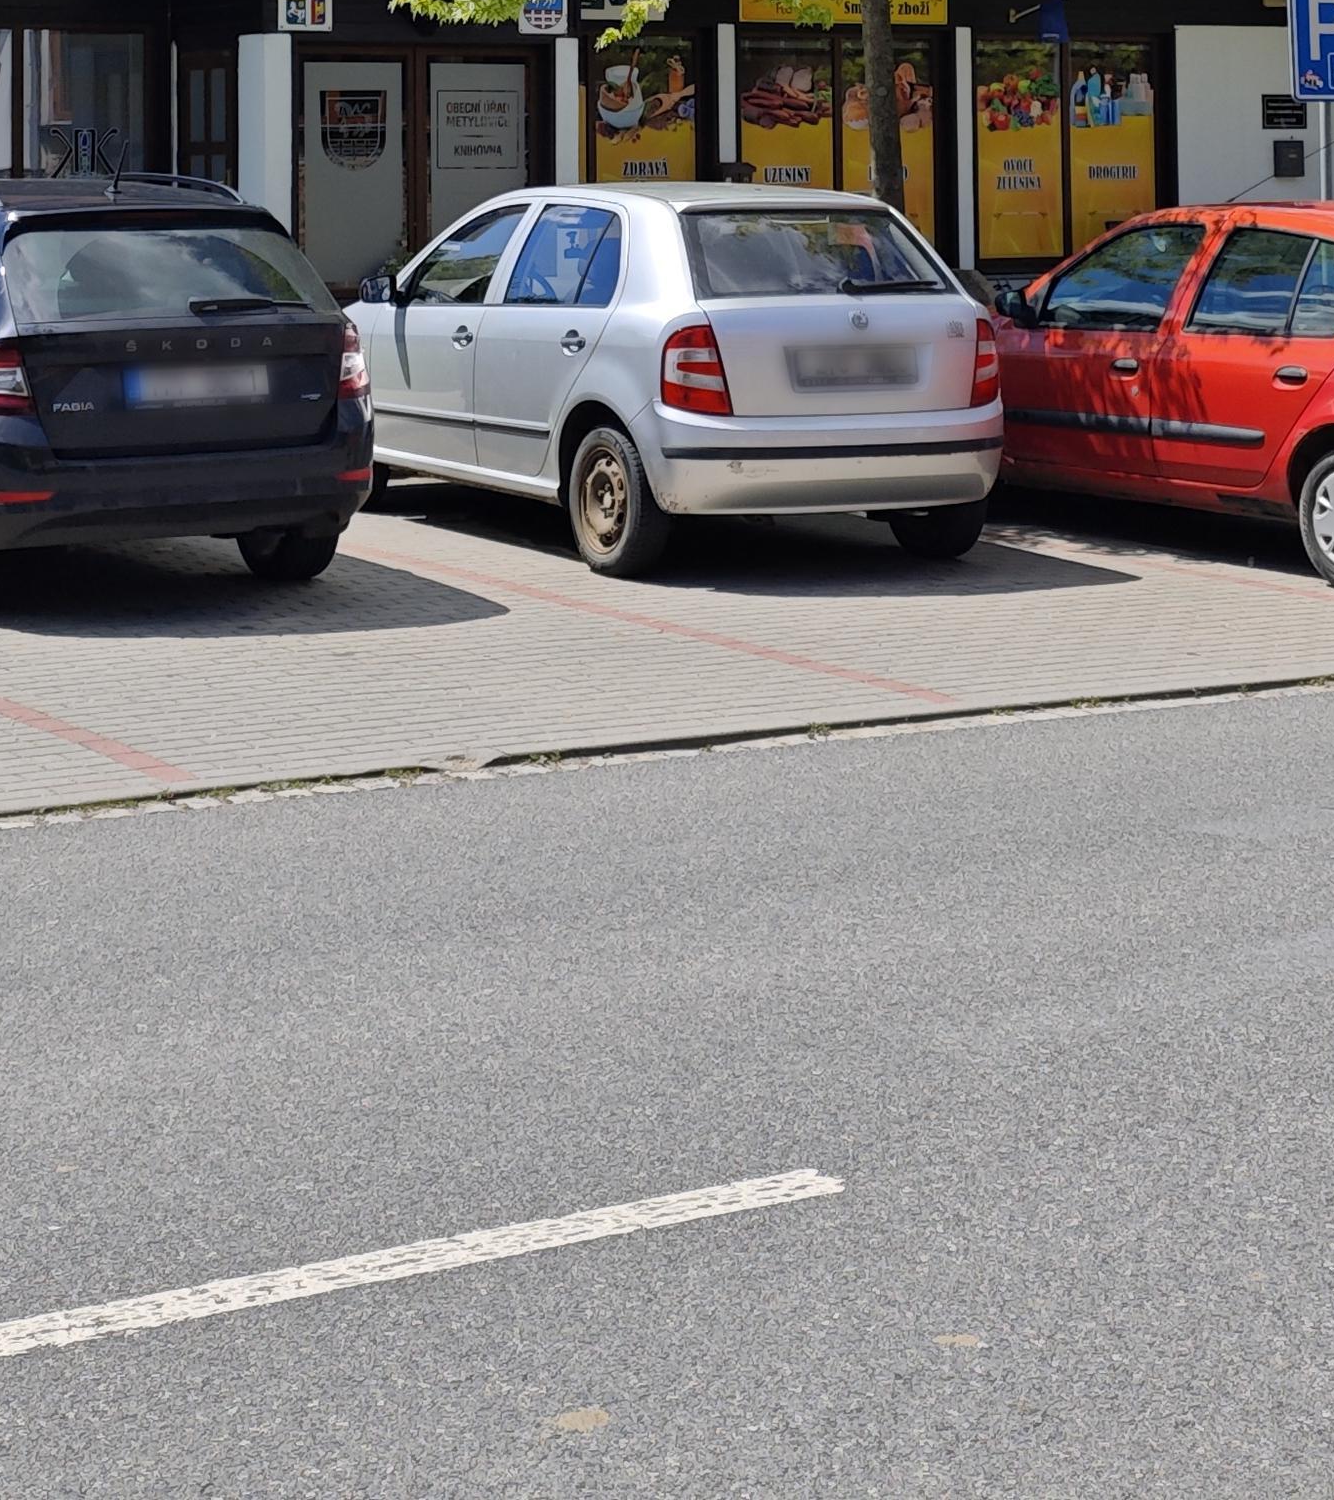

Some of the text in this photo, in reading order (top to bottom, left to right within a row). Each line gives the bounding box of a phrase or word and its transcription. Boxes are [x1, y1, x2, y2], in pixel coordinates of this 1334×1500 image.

[897, 1, 930, 16] zboží
[446, 99, 480, 114] OBECNÍ
[454, 145, 503, 157] KNIHOVNA
[623, 158, 668, 176] ZDRAVÁ
[1003, 159, 1035, 173] OVOCE
[1088, 165, 1138, 180] DROGERIE
[764, 167, 811, 183] UZENINY
[996, 176, 1041, 190] ZELENINA
[125, 337, 273, 352] ŠKODA
[52, 401, 95, 412] FABIA
